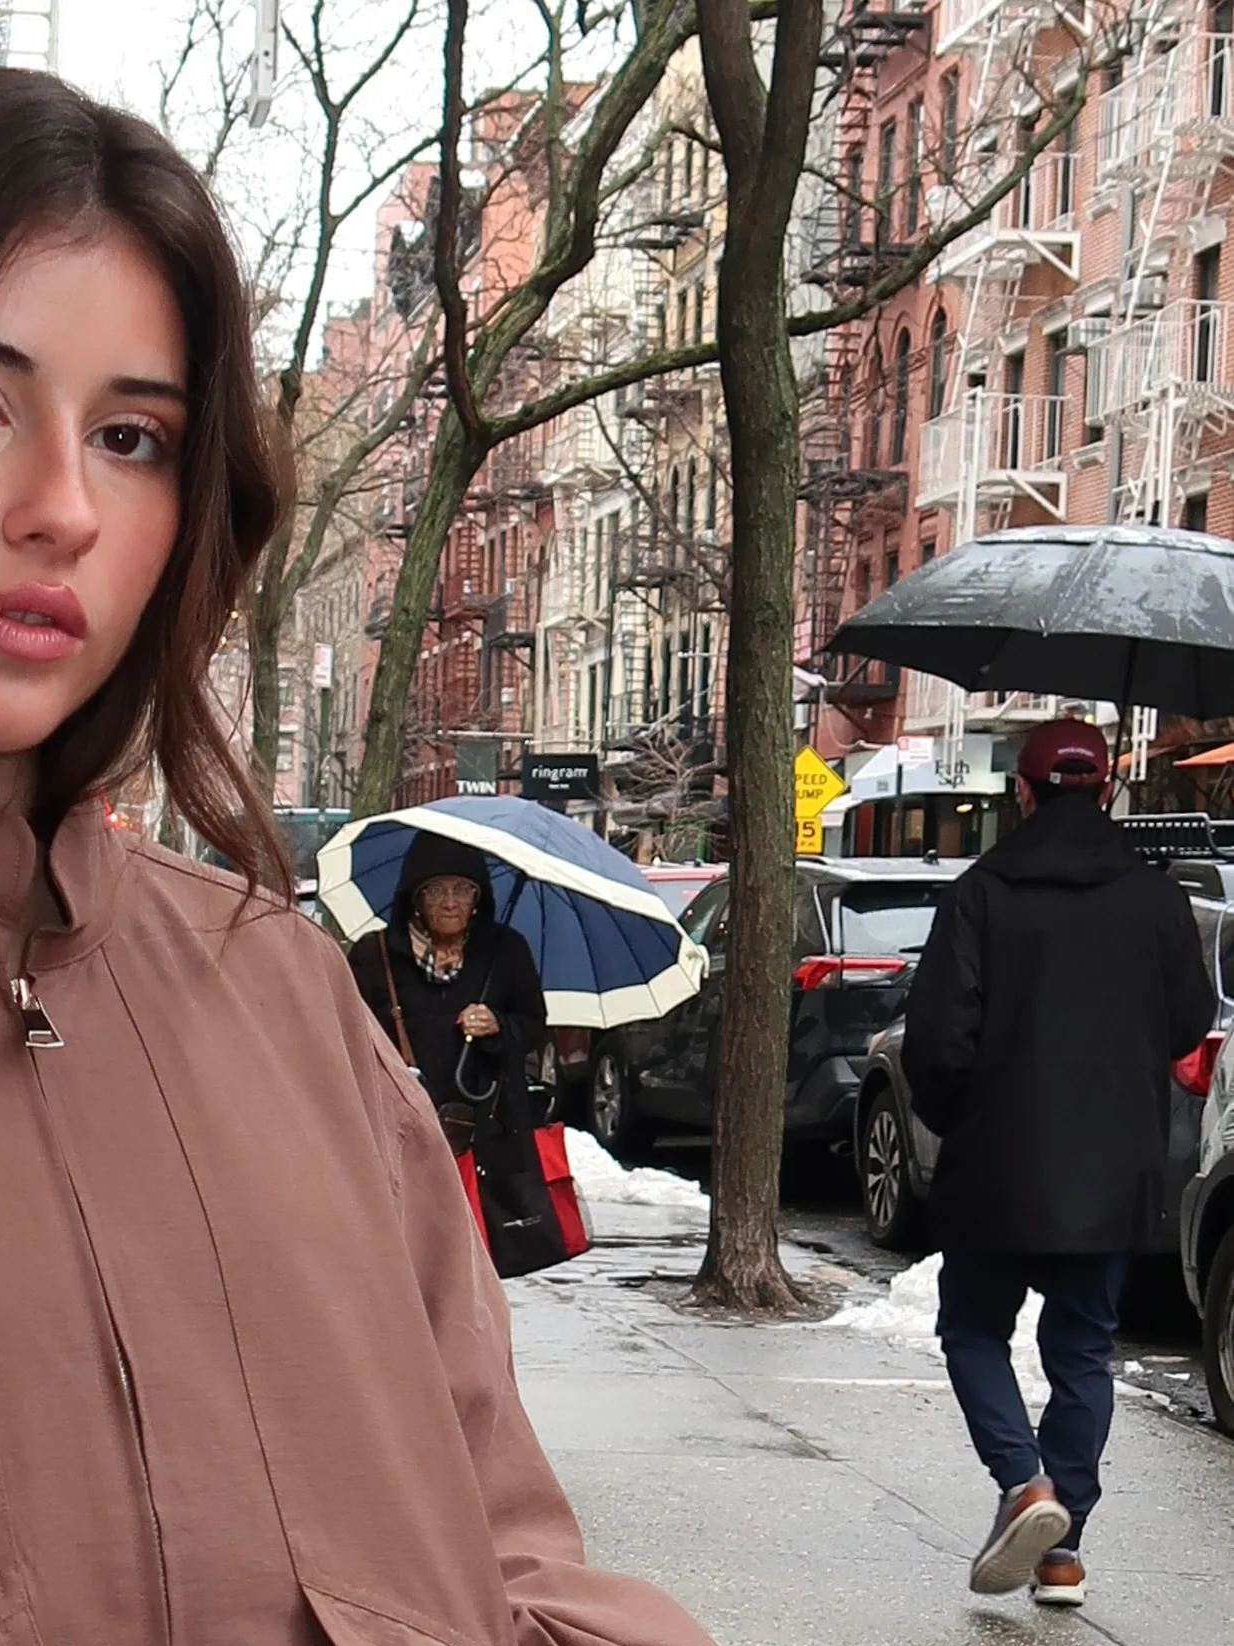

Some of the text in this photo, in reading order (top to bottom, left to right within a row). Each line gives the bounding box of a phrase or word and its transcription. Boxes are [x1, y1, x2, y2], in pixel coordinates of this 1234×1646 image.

[794, 773, 828, 786] PEED
[456, 780, 497, 795] TWIN
[796, 788, 823, 800] UMP
